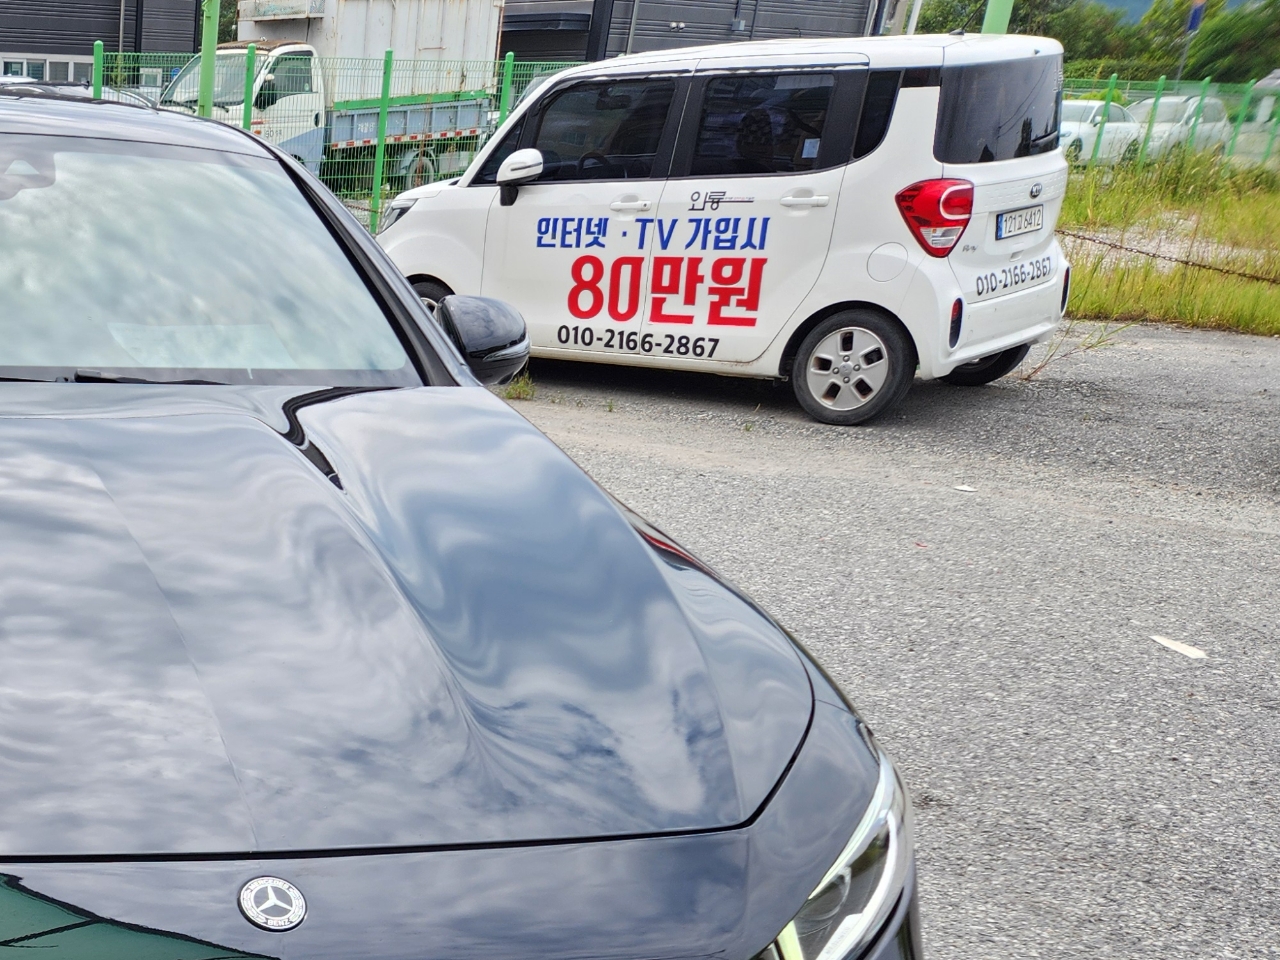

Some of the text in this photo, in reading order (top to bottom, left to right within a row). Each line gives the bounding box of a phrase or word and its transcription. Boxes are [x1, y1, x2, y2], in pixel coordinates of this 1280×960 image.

[537, 217, 610, 248] 인터넷
[635, 218, 679, 250] TV
[685, 217, 770, 250] 가입시
[567, 255, 768, 327] 80만원
[976, 256, 1051, 296] 010-2166-2867
[557, 325, 720, 358] 010-2166-2867
[267, 918, 290, 927] BENZ
